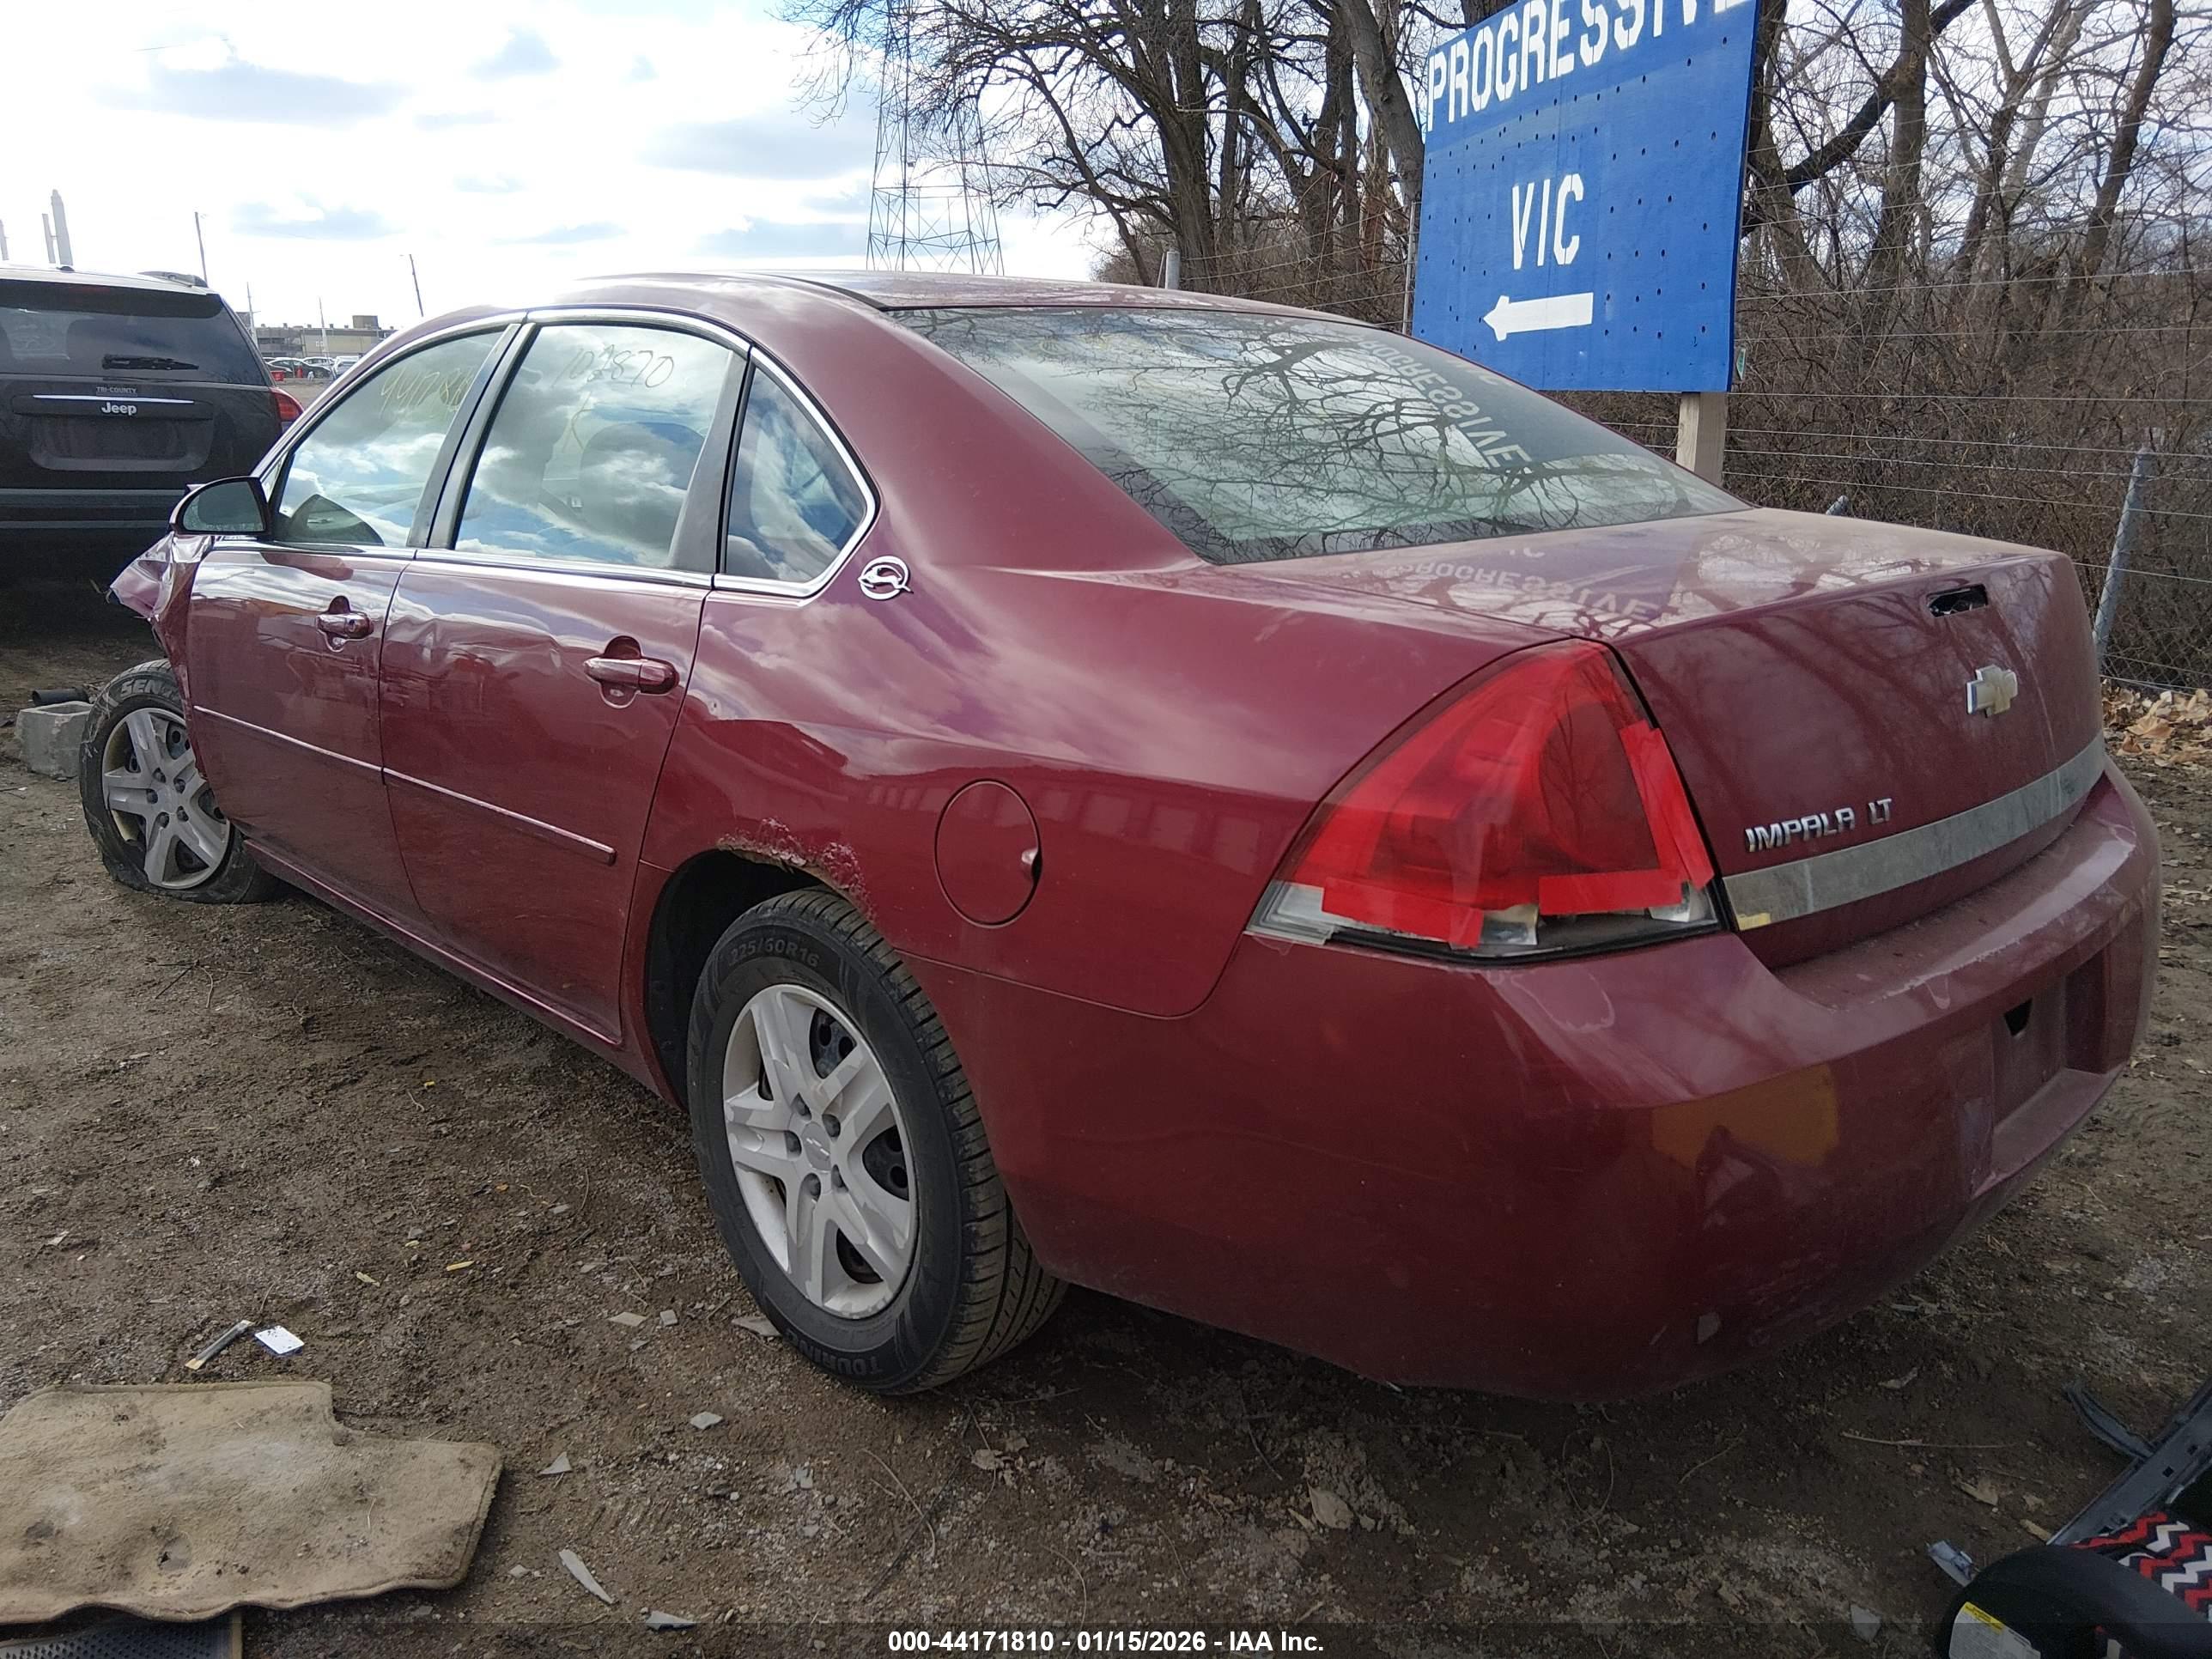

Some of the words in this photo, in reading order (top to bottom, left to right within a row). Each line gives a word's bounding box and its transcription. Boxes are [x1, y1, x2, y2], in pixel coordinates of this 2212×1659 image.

[1428, 0, 1752, 131] PROGRESS
[1512, 173, 1583, 270] VIC
[101, 402, 137, 416] Jeep
[1745, 807, 1856, 853] IMPALA
[1868, 798, 1893, 825] LT
